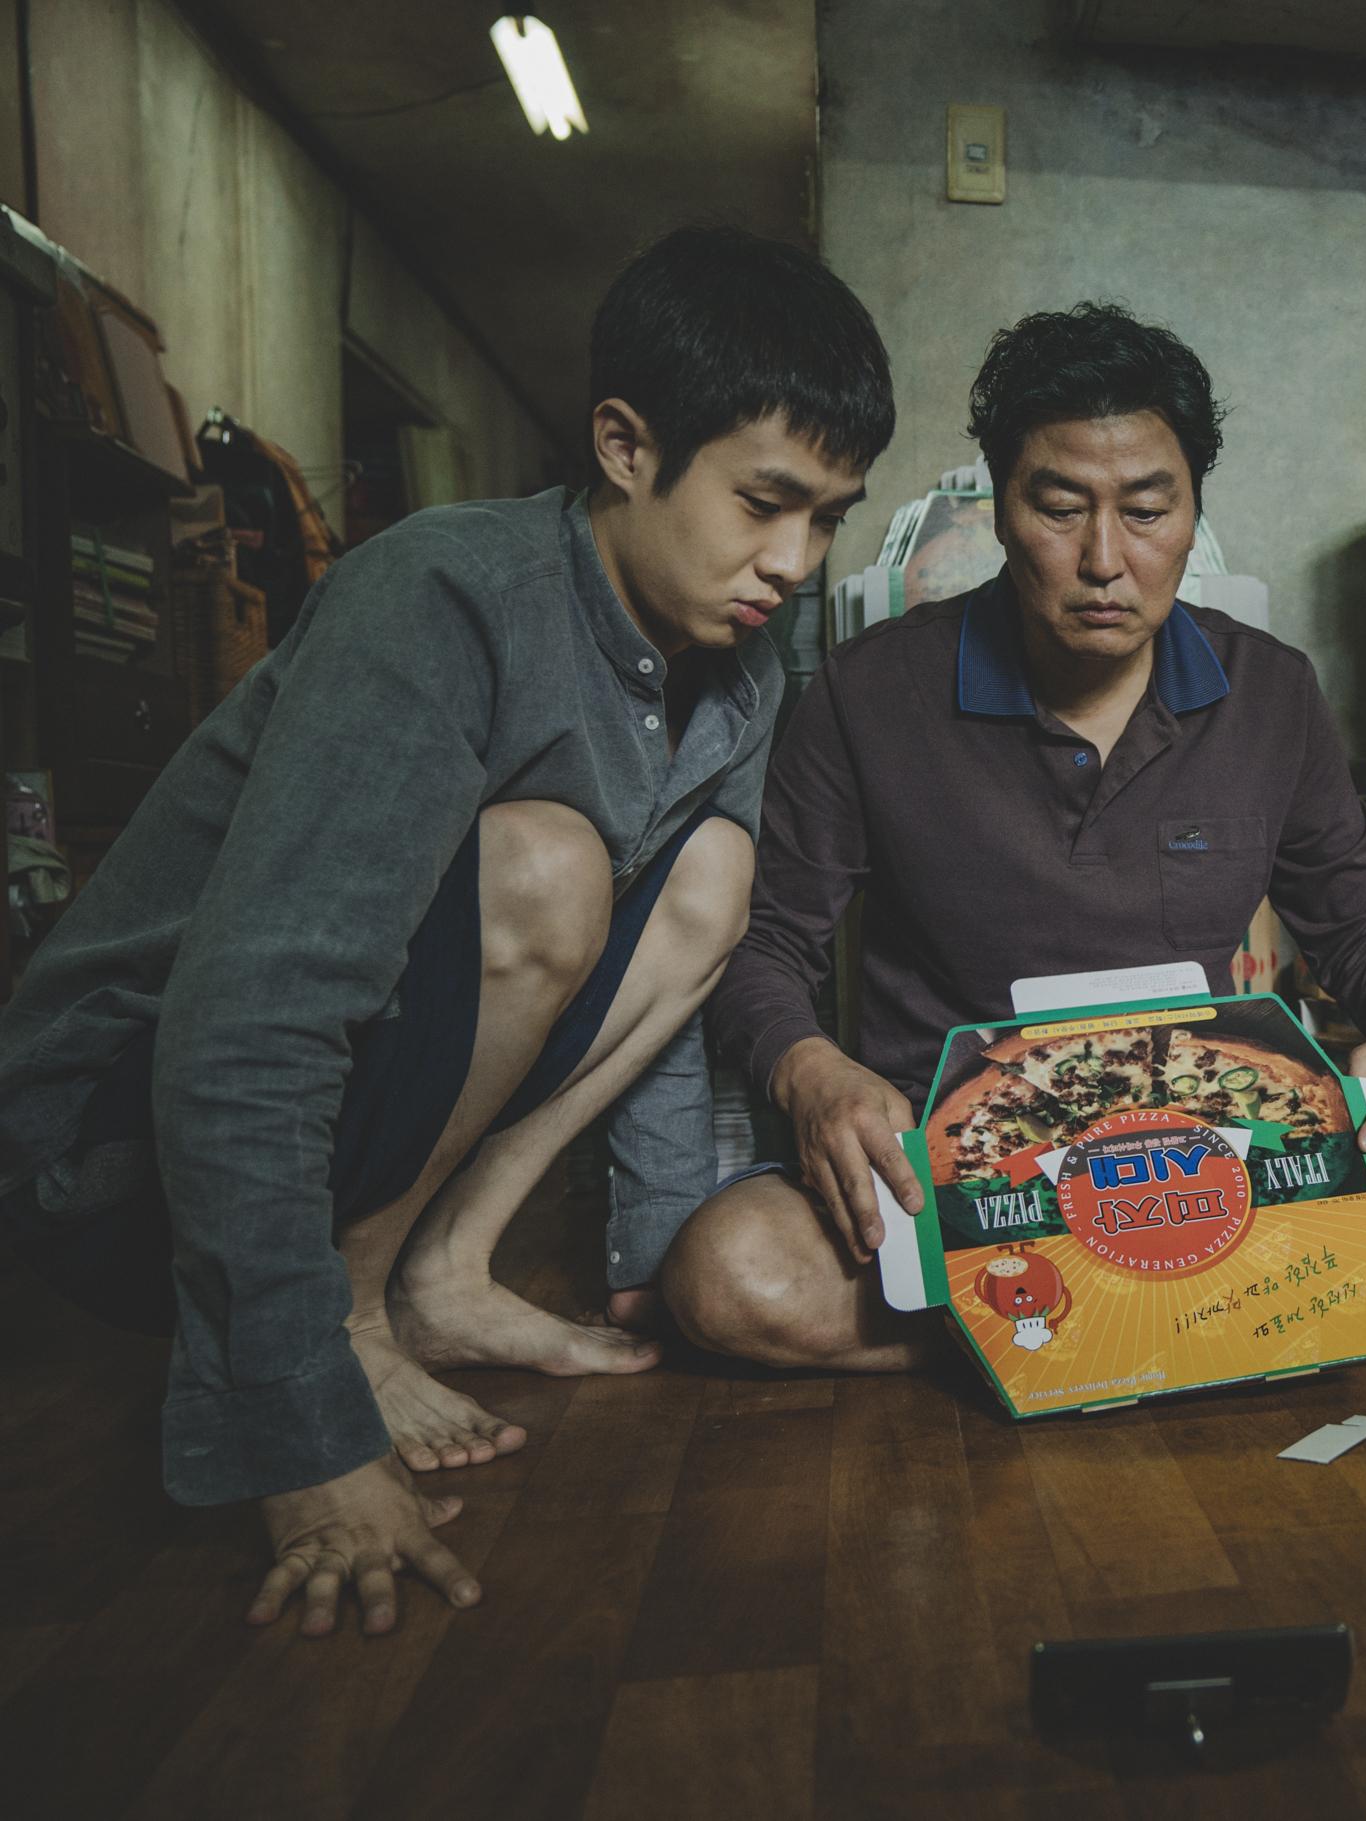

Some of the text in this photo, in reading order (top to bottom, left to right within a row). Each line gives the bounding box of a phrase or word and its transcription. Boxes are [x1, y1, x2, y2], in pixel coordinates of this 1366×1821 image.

[1061, 1172, 1078, 1220] FRESH
[1076, 1121, 1112, 1150] PURE
[1120, 1112, 1169, 1124] PIZZA
[1087, 1144, 1211, 1191] 시대
[1193, 1124, 1246, 1199] SINCE 2010
[1264, 1152, 1330, 1190] ITALY
[974, 1190, 1043, 1230] PIZZA
[1093, 1188, 1229, 1236] 피자
[1086, 1216, 1241, 1271] PIZZA GENERATION
[1284, 1245, 1338, 1287] 푸짐한
[1308, 1282, 1358, 1319] 신선한
[1068, 1380, 1108, 1394] Delivery
